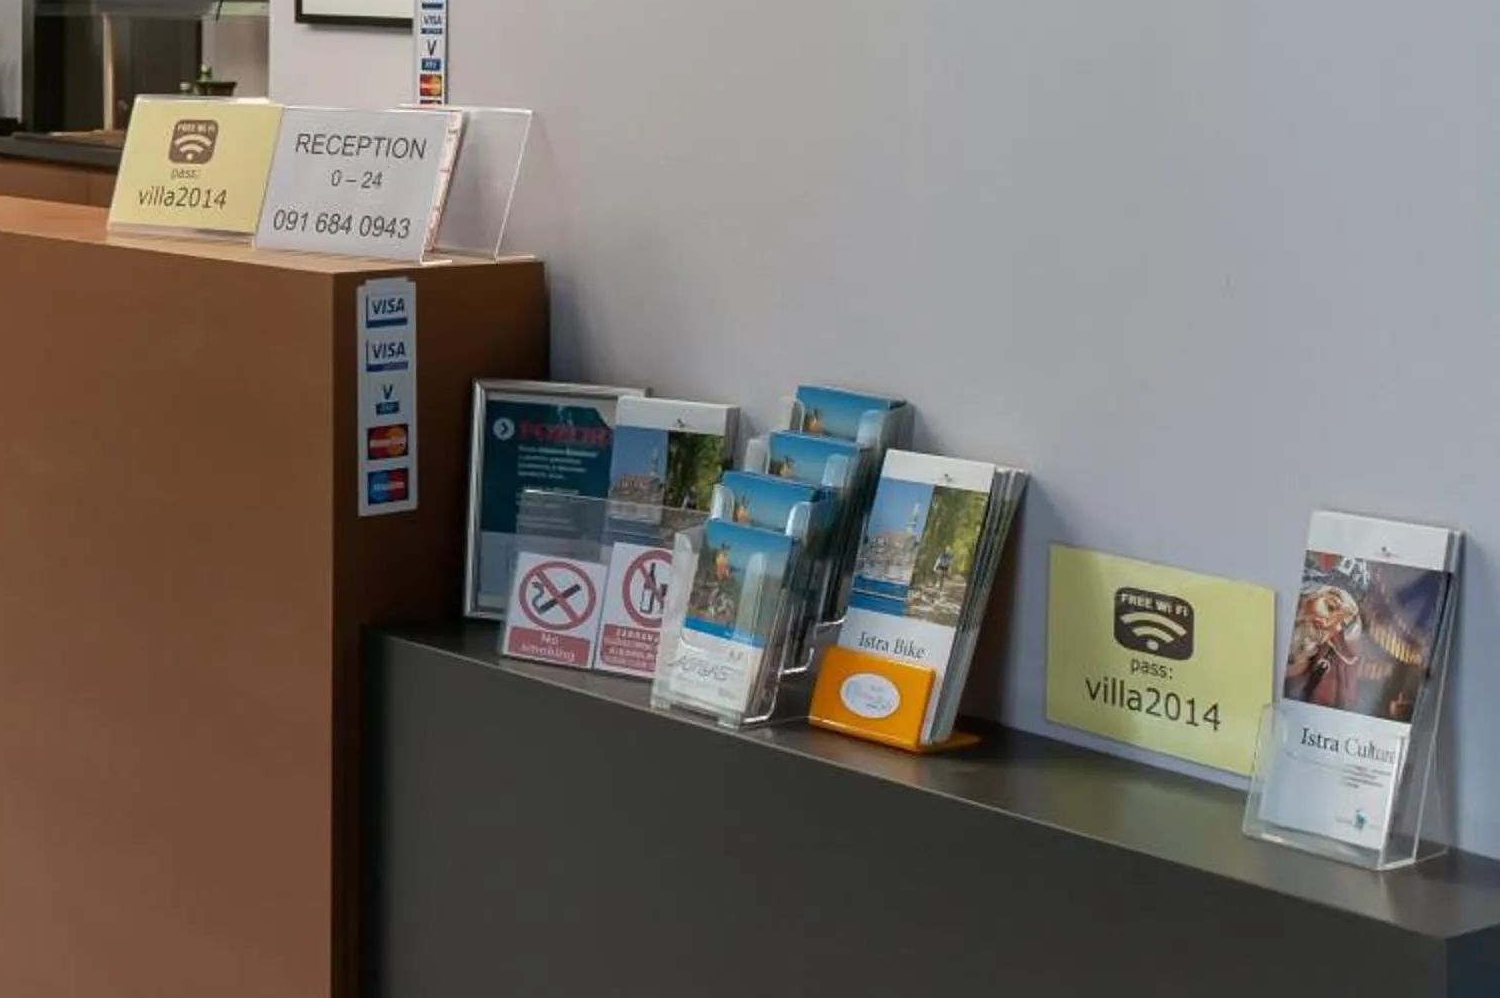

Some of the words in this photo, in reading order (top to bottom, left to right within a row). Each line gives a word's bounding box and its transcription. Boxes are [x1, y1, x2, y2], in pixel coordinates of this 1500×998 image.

[295, 133, 427, 160] RECEPTION
[331, 169, 342, 187] 0
[361, 171, 382, 189] 24
[138, 185, 228, 210] villa2014
[273, 209, 309, 233] 091
[315, 212, 352, 235] 684
[359, 215, 411, 239] 0943
[372, 297, 405, 315] VISA
[372, 342, 406, 359] VISA
[383, 384, 393, 400] V
[1121, 593, 1152, 609] FREE
[859, 630, 889, 652] Istra
[893, 637, 925, 658] Bike
[1131, 658, 1173, 680] pass:
[1085, 676, 1221, 732] villa2014
[1300, 727, 1339, 754] Istra
